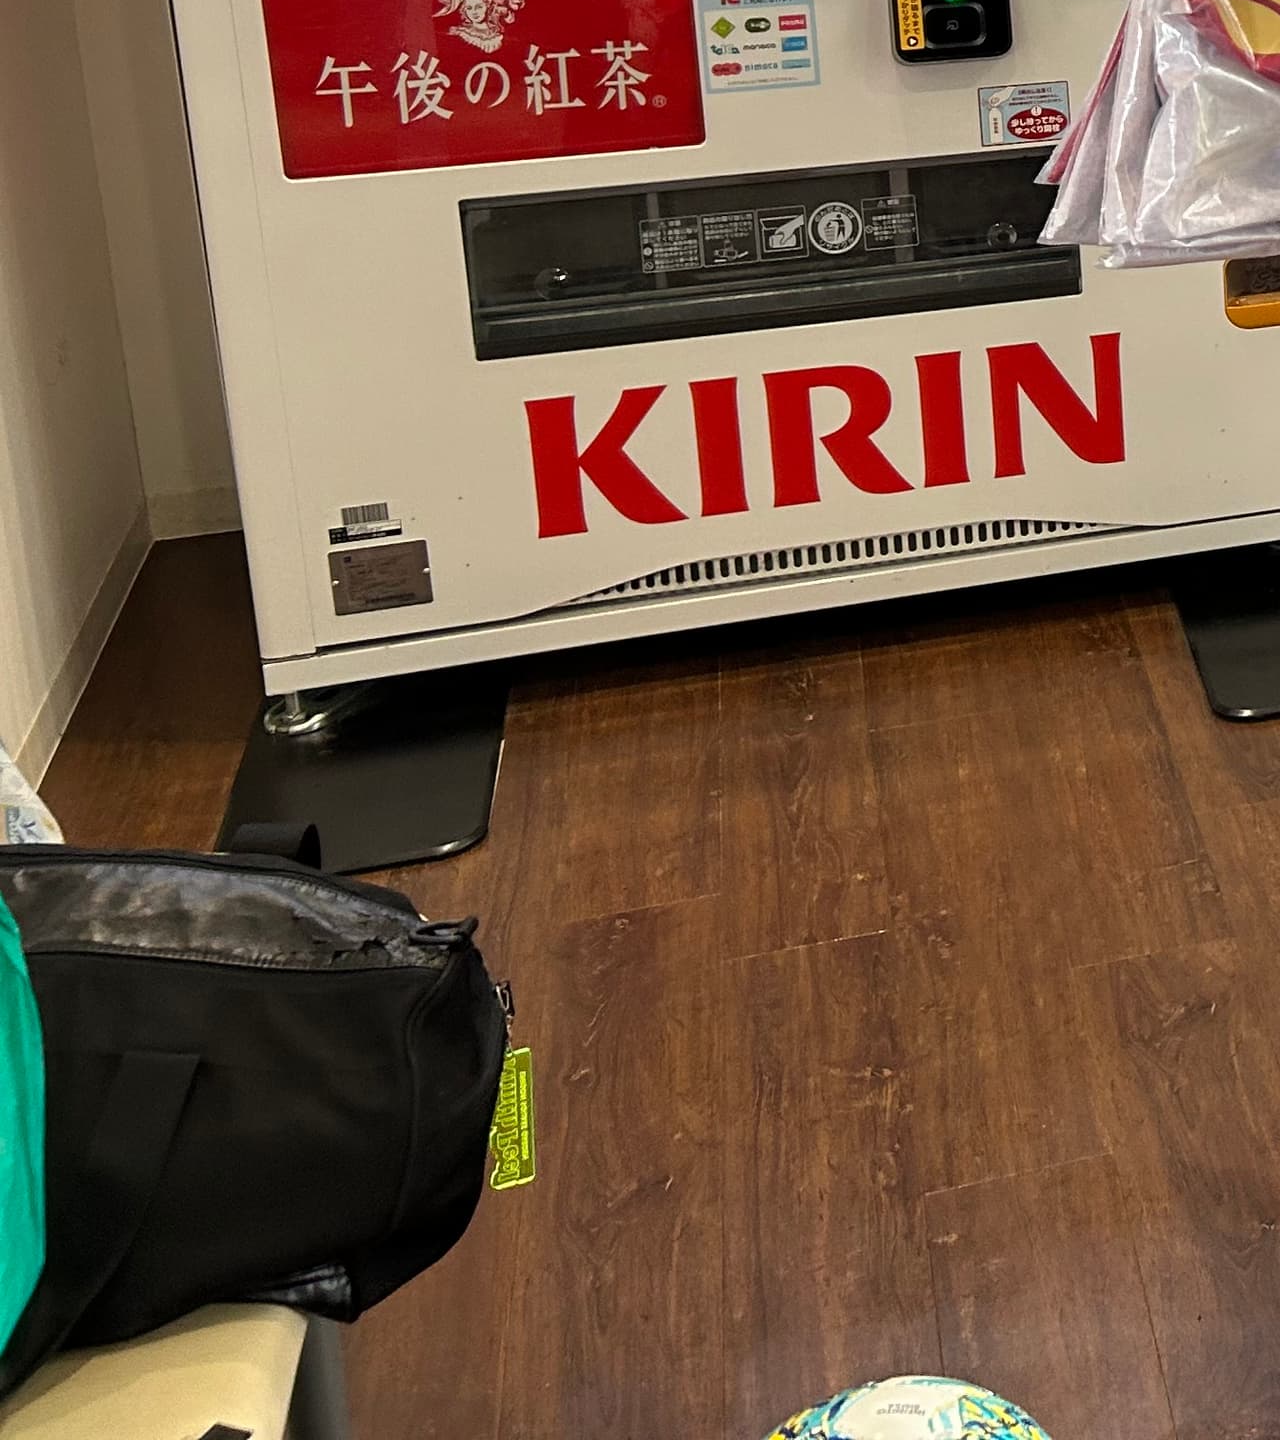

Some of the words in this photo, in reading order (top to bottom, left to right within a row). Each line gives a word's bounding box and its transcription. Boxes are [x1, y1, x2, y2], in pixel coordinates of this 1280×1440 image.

[314, 39, 653, 129] 午後の紅茶
[745, 63, 778, 71] nimoca
[523, 331, 1127, 540] KIRIN
